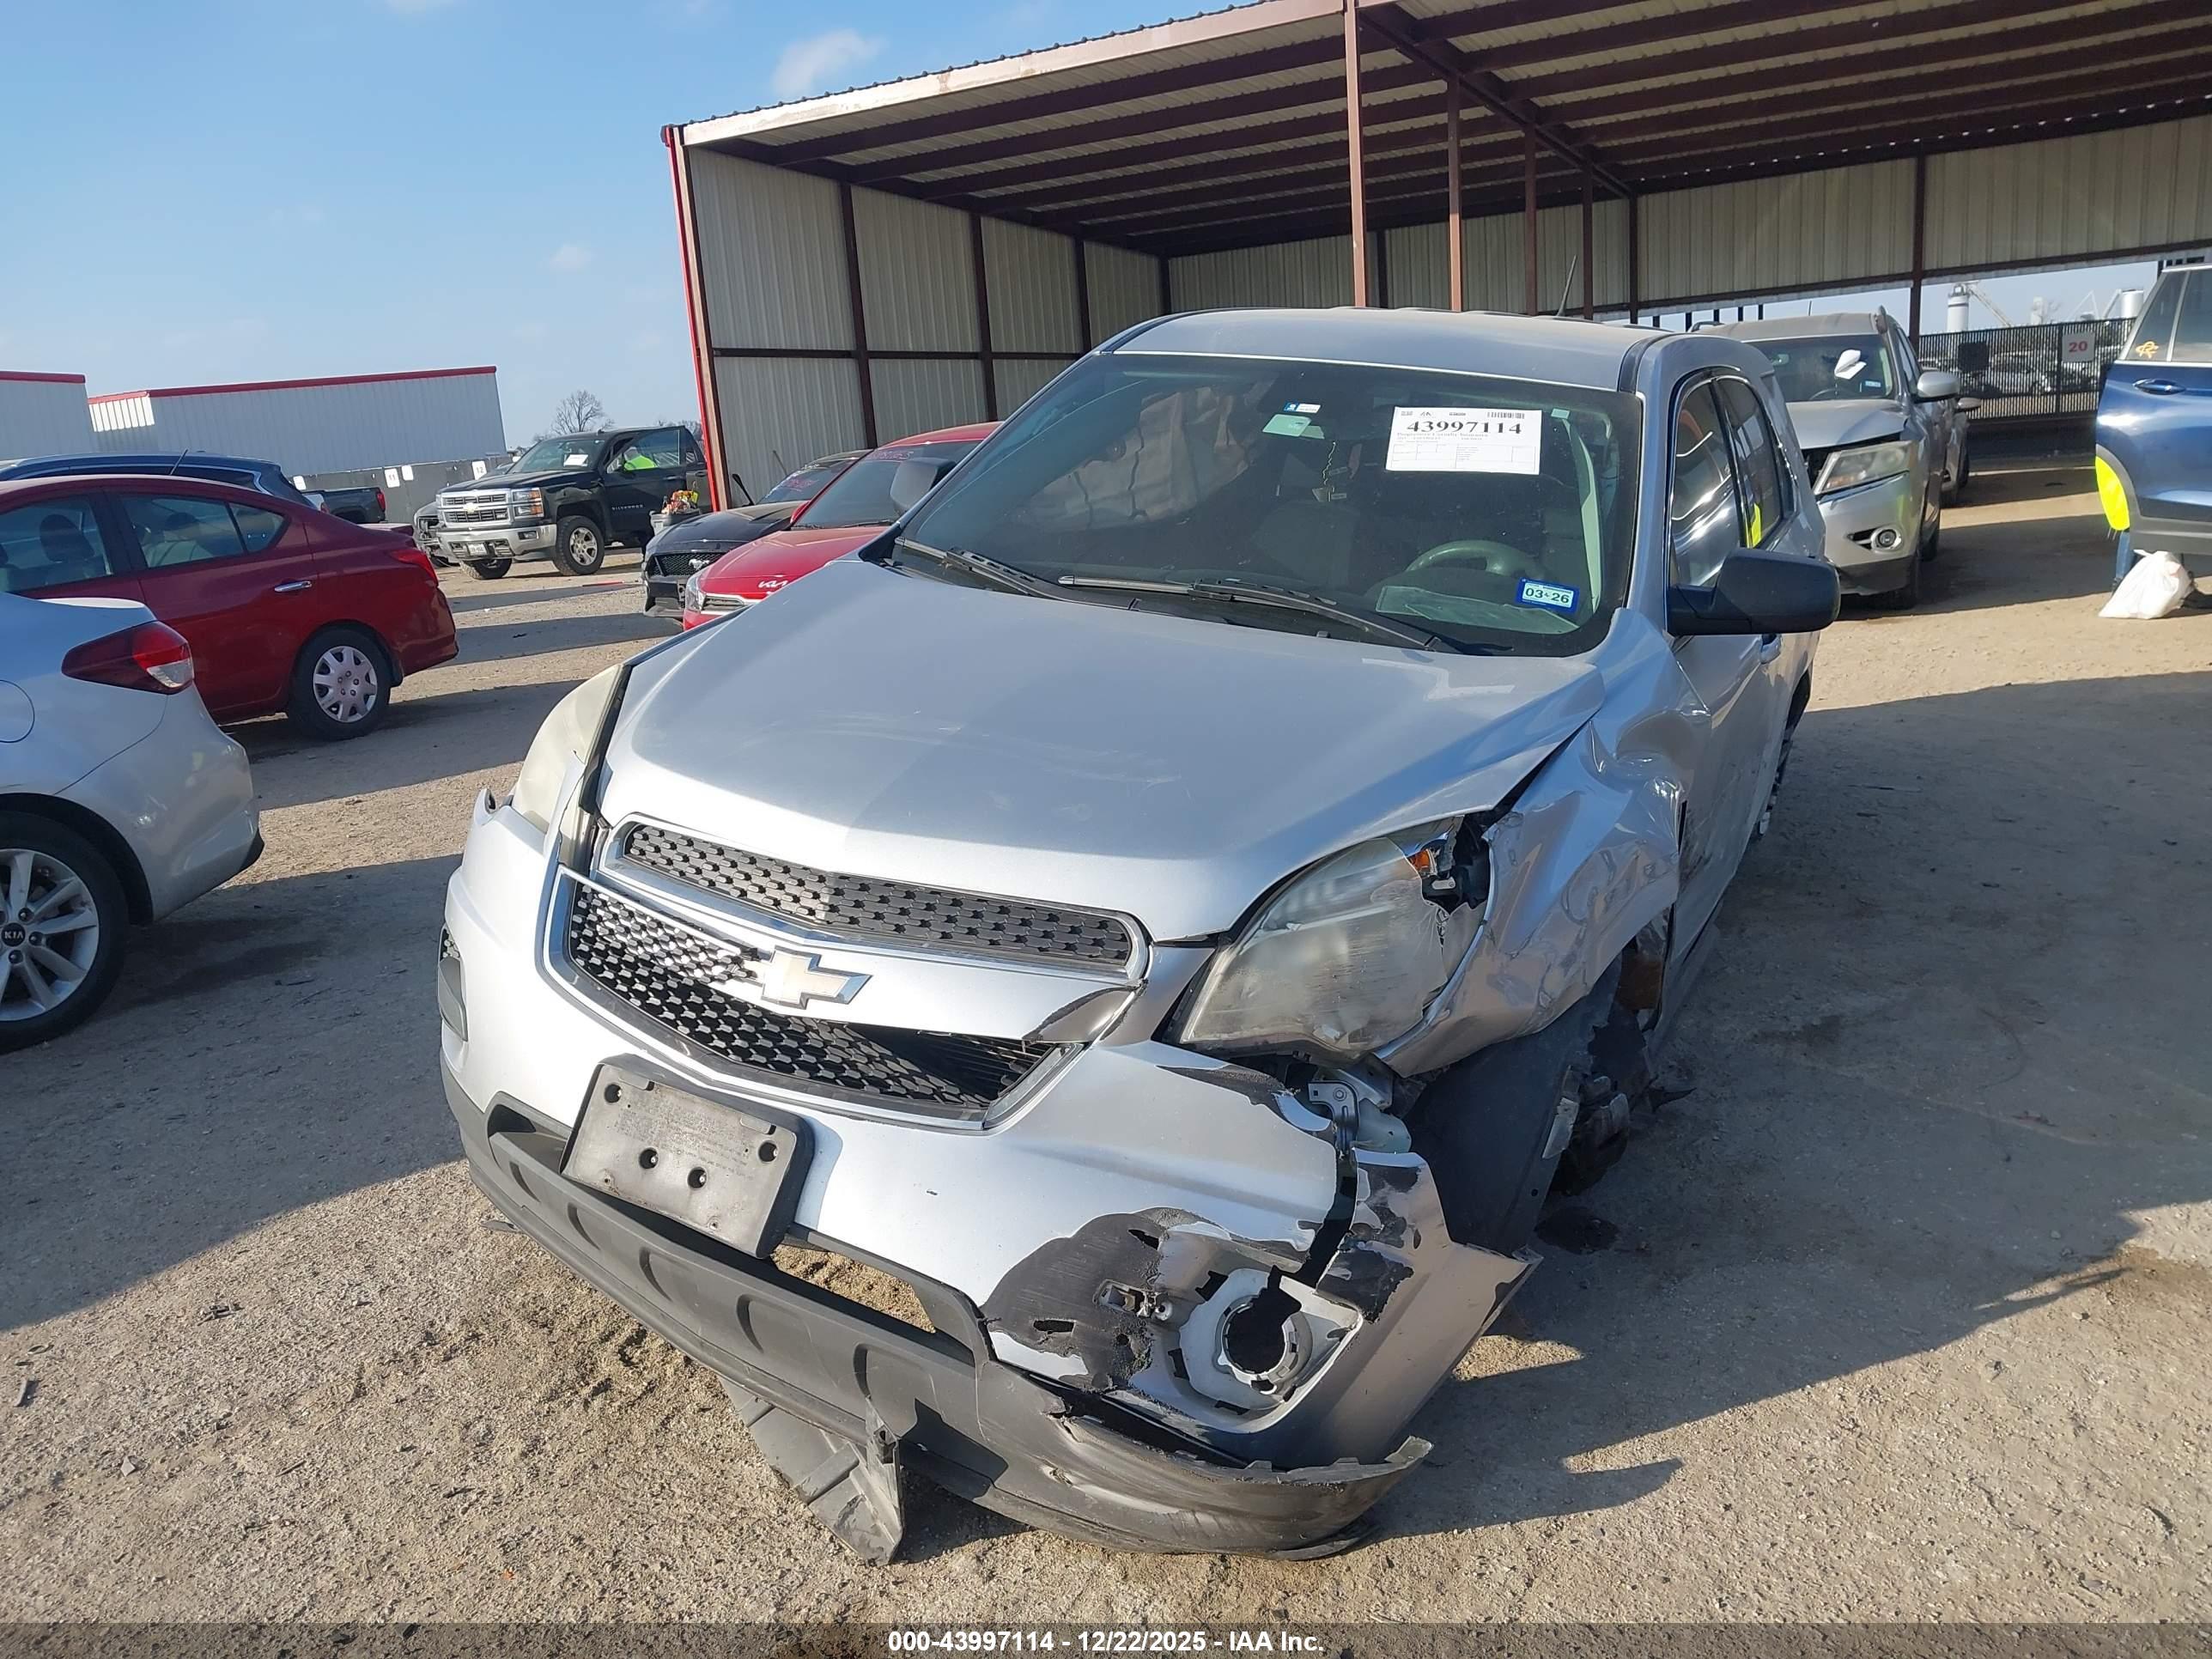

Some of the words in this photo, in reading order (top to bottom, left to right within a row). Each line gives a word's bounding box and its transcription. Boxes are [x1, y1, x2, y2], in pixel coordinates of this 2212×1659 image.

[2069, 341, 2088, 352] 20
[1407, 421, 1522, 434] 43997114
[1525, 587, 1543, 599] 03
[1551, 592, 1569, 604] 26
[4, 931, 24, 939] KIA
